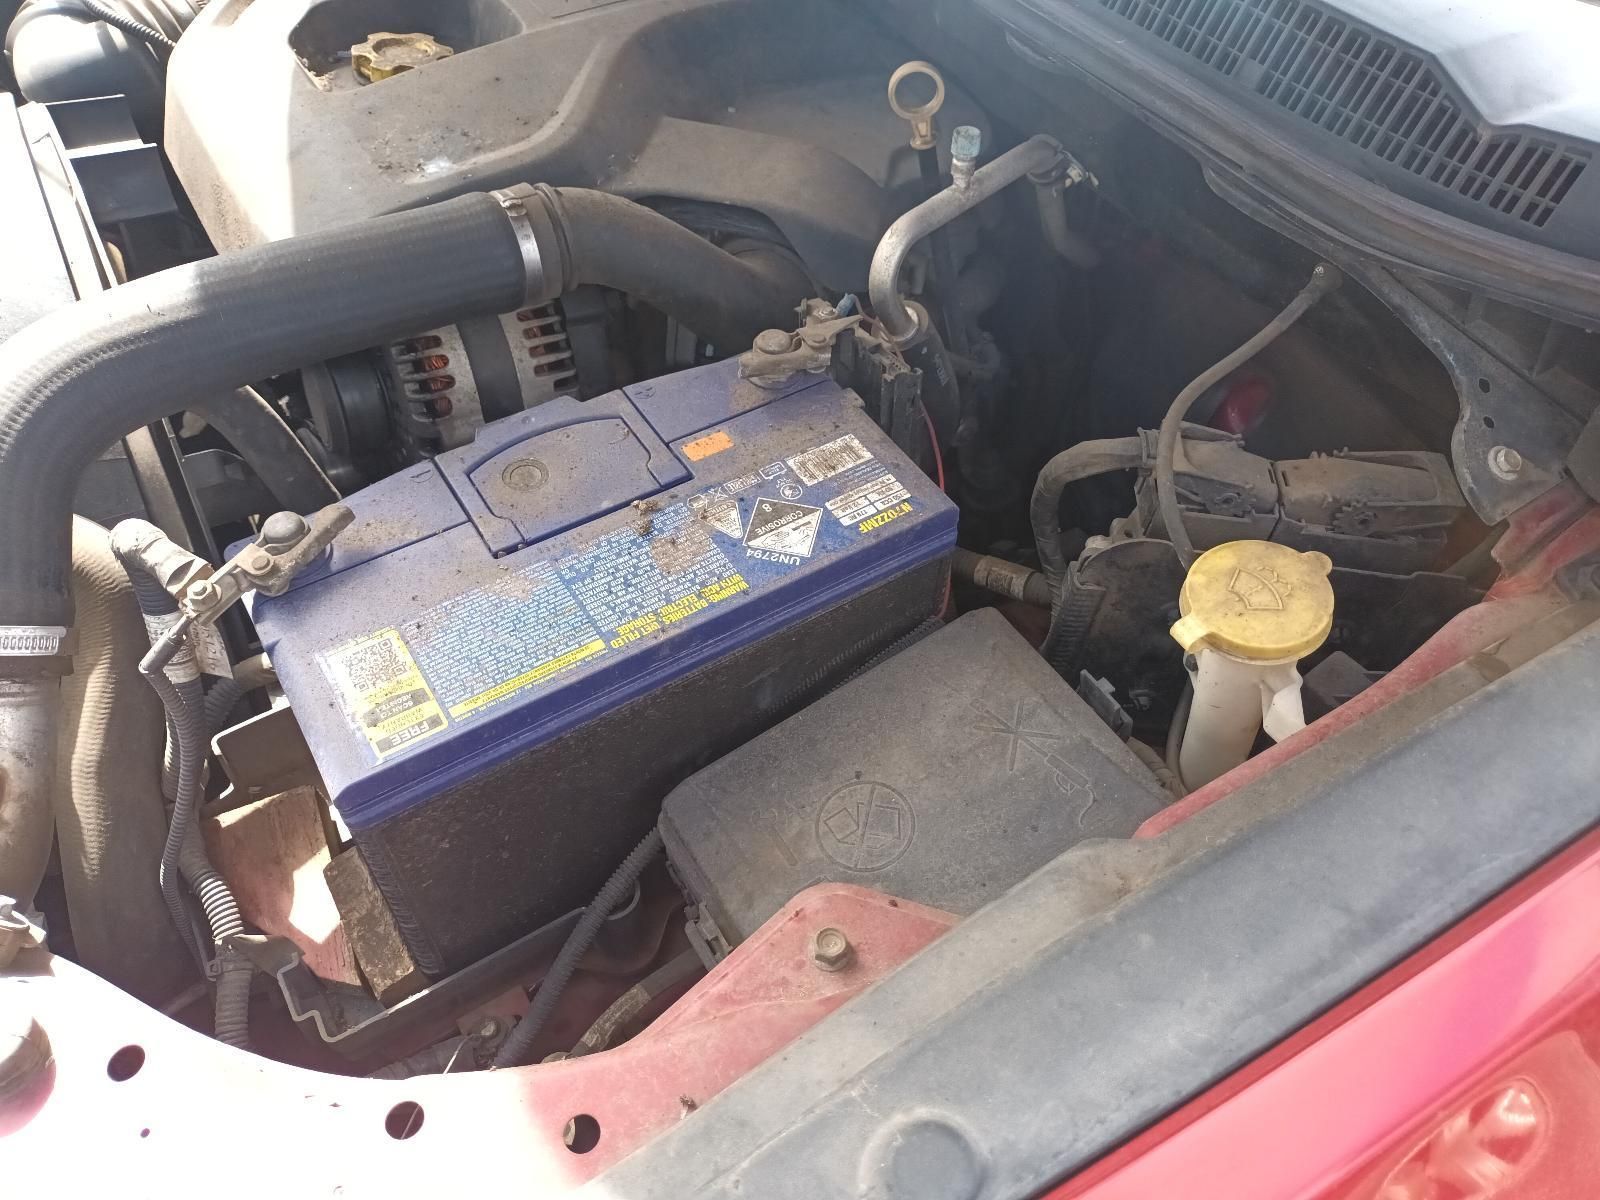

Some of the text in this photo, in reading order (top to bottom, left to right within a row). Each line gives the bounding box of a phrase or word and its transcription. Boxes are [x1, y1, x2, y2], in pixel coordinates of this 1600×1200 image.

[760, 502, 773, 512] 8
[753, 509, 804, 536] CORROSIVE
[745, 547, 799, 565] UN2794
[718, 572, 743, 588] WITH
[705, 579, 749, 604] WARNING:
[611, 611, 657, 637] STORAGE.
[638, 620, 661, 635] WET
[608, 629, 641, 649] FILLED
[387, 719, 431, 746] FREE
